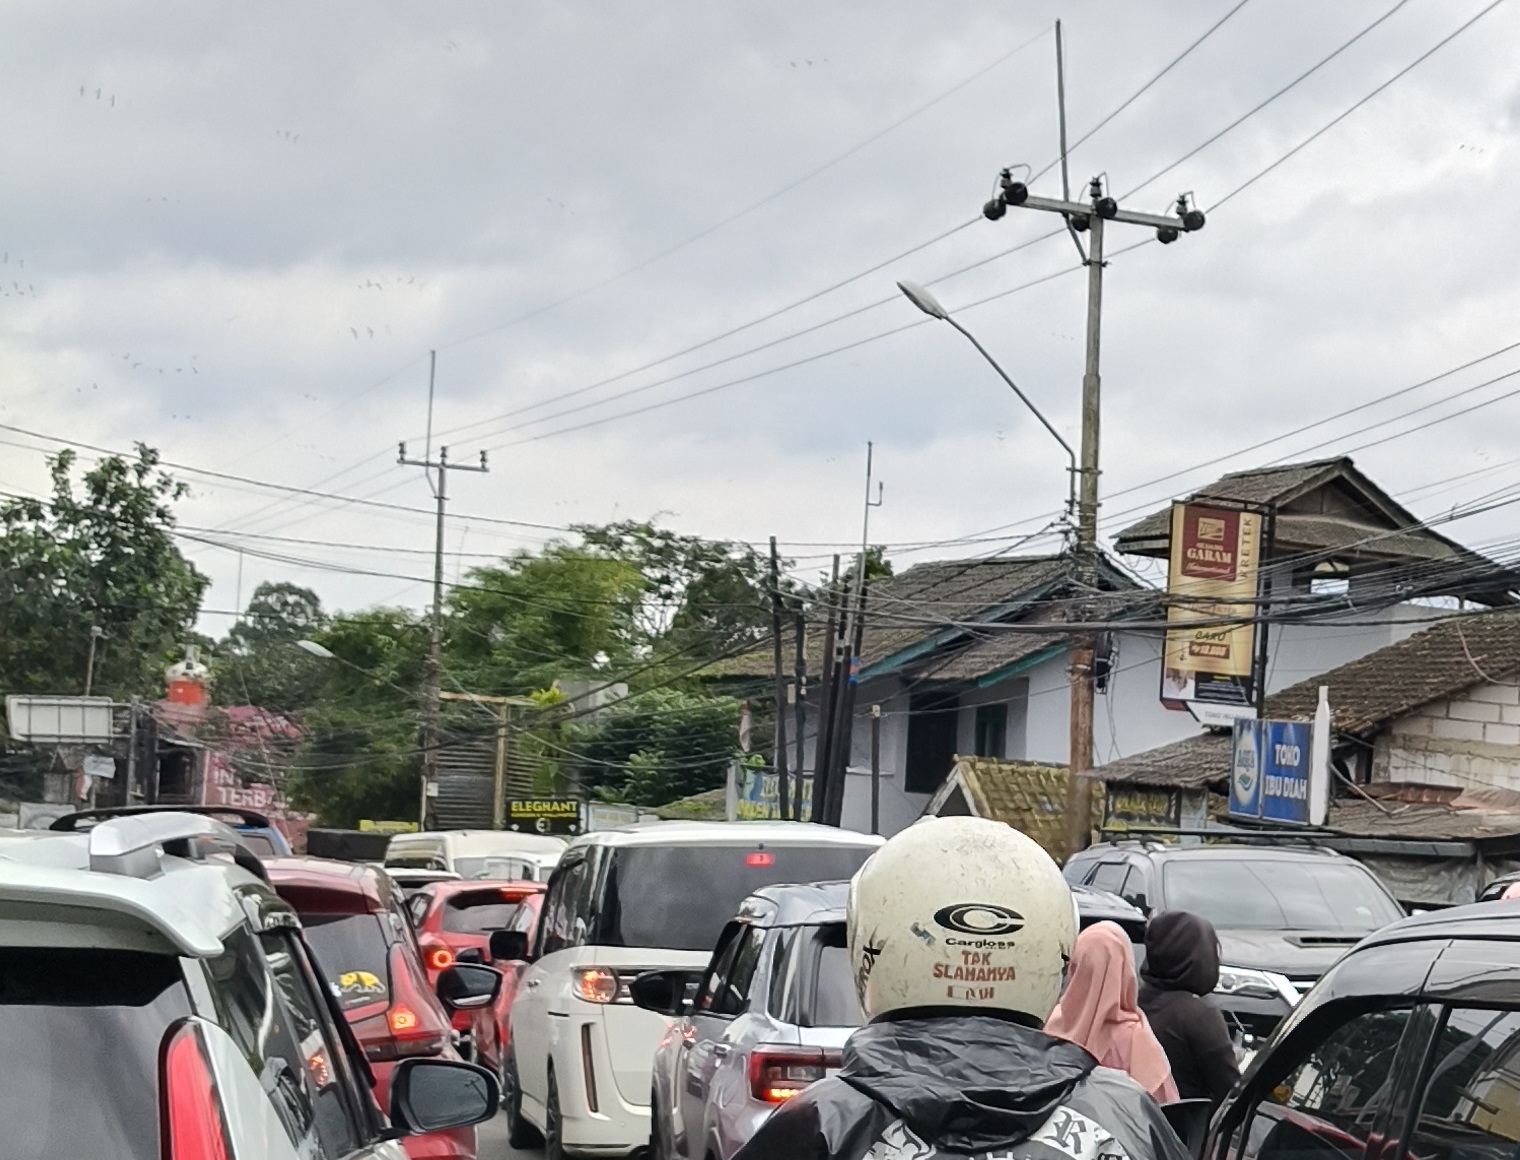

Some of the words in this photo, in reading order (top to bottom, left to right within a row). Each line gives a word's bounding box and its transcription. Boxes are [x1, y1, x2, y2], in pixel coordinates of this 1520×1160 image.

[1186, 548, 1232, 563] GARAM
[1275, 744, 1301, 766] TOKO
[1265, 775, 1282, 796] IBU
[1283, 777, 1307, 800] DIAH
[945, 938, 1016, 949] Cargloss
[961, 949, 992, 966] TAK
